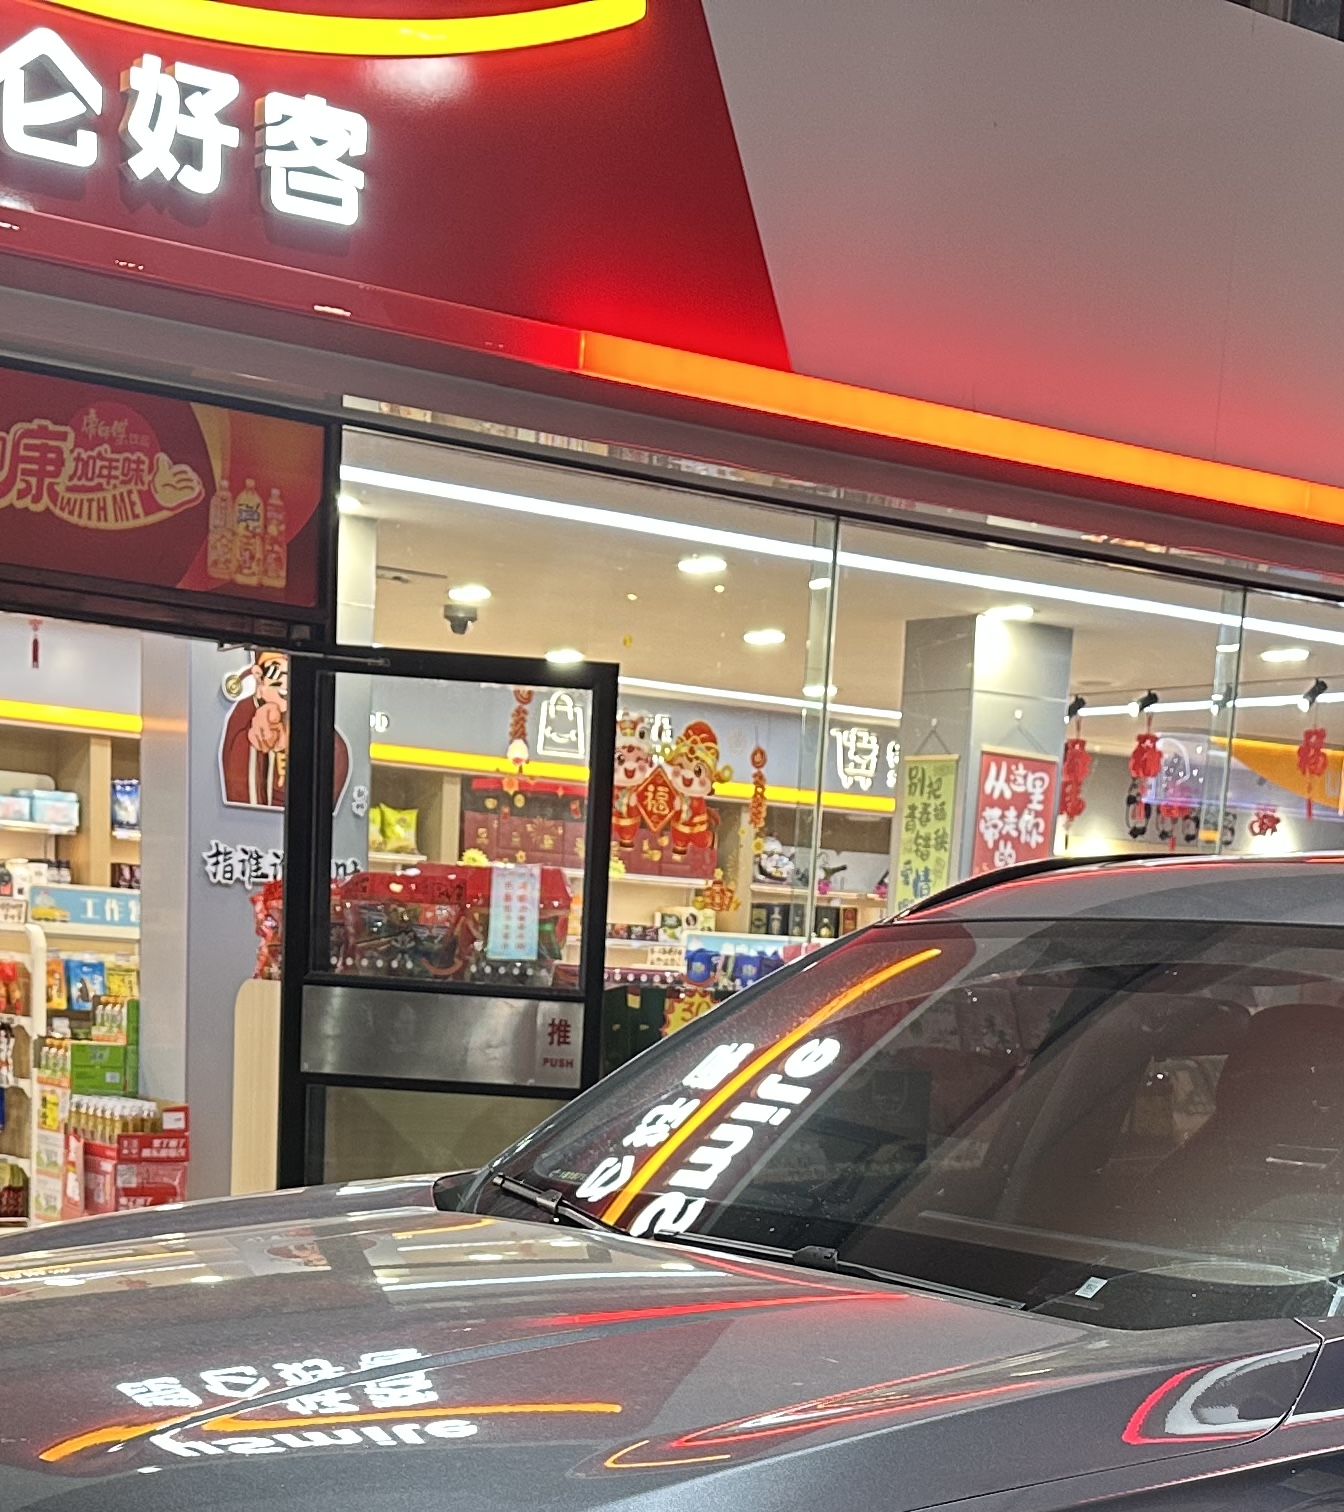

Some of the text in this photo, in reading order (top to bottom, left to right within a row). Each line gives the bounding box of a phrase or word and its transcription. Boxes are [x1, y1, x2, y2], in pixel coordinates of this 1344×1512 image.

[59, 489, 143, 523] WITH ME
[644, 784, 671, 814] 福
[984, 761, 1050, 811] 从这里
[979, 806, 1045, 849] 带走你
[548, 1018, 572, 1047] 推
[542, 1058, 574, 1069] PUSH
